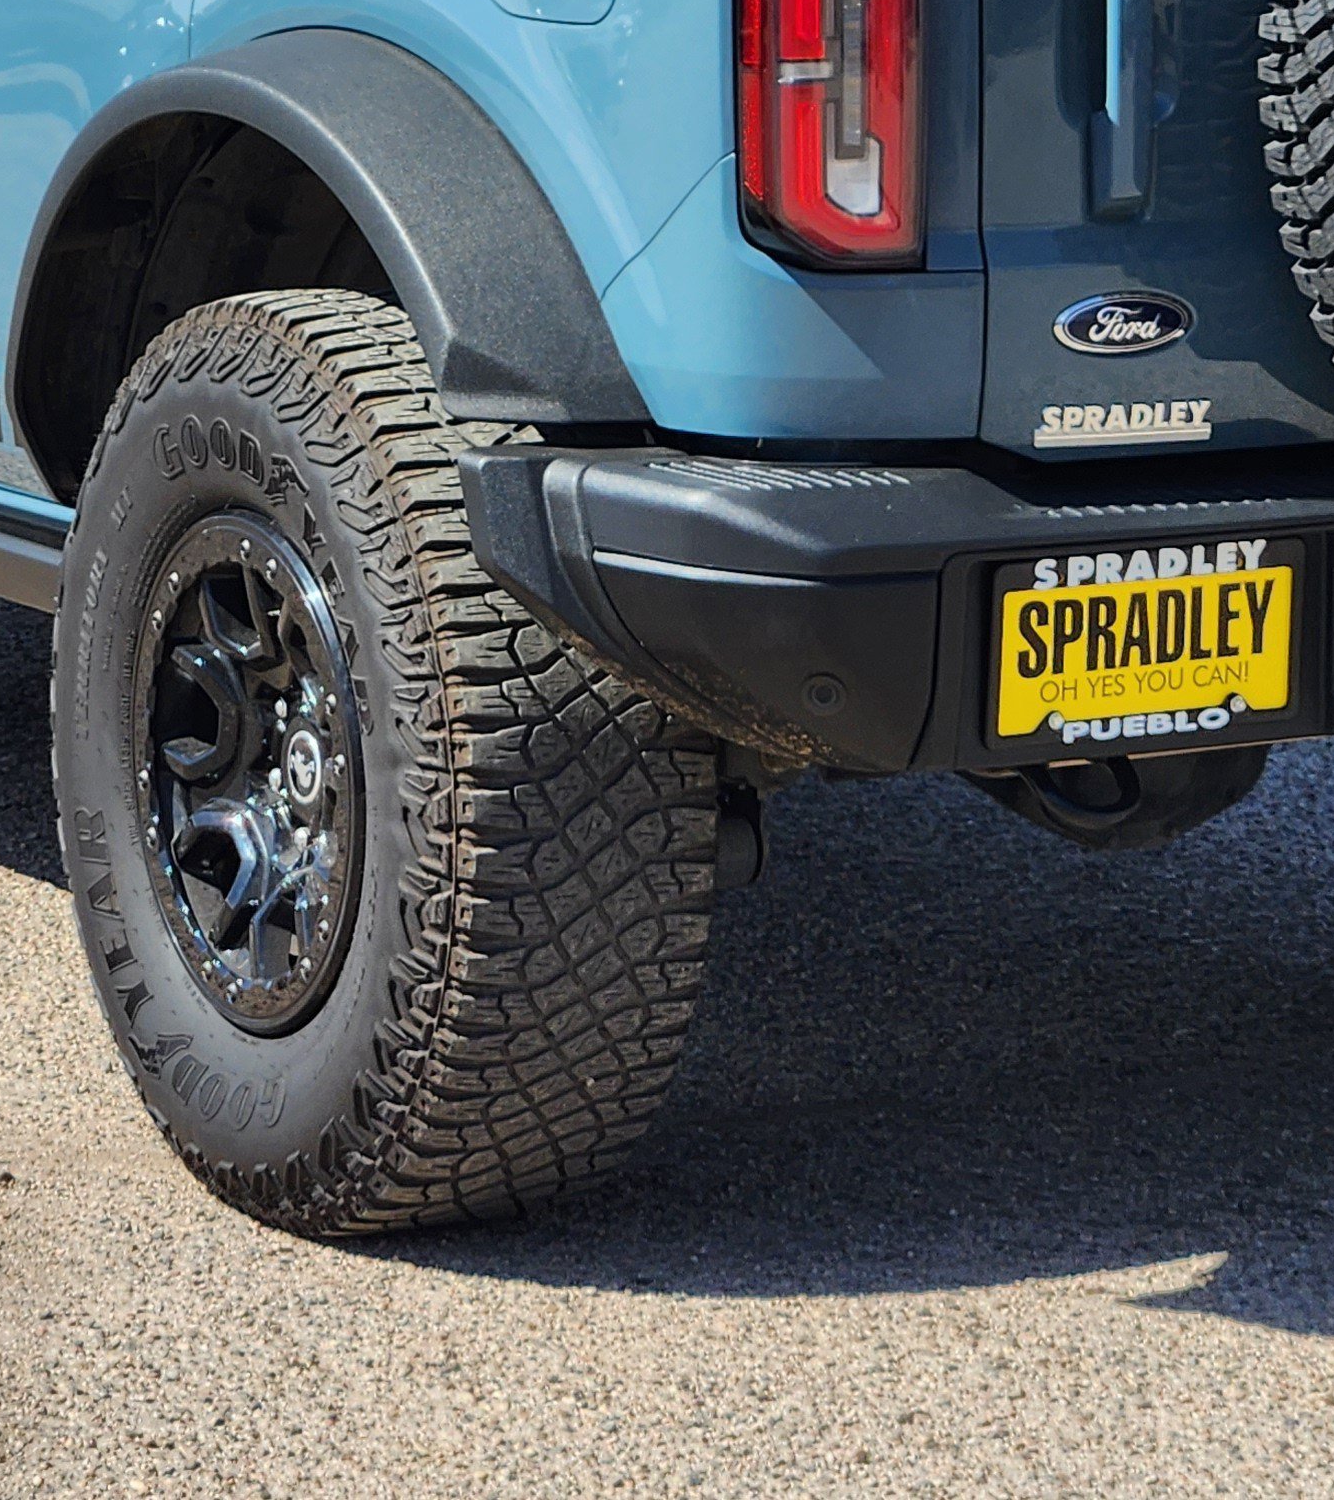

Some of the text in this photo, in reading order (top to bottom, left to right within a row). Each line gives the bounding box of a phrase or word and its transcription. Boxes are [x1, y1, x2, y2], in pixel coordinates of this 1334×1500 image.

[1087, 305, 1162, 343] Ford
[1039, 398, 1212, 435] SPRADLEY
[1032, 537, 1268, 591] SPRADLEY
[1017, 577, 1276, 679] SPRADLEY
[1039, 660, 1250, 704] OH YES YOU CAN!
[1061, 707, 1231, 745] PUEBLO
